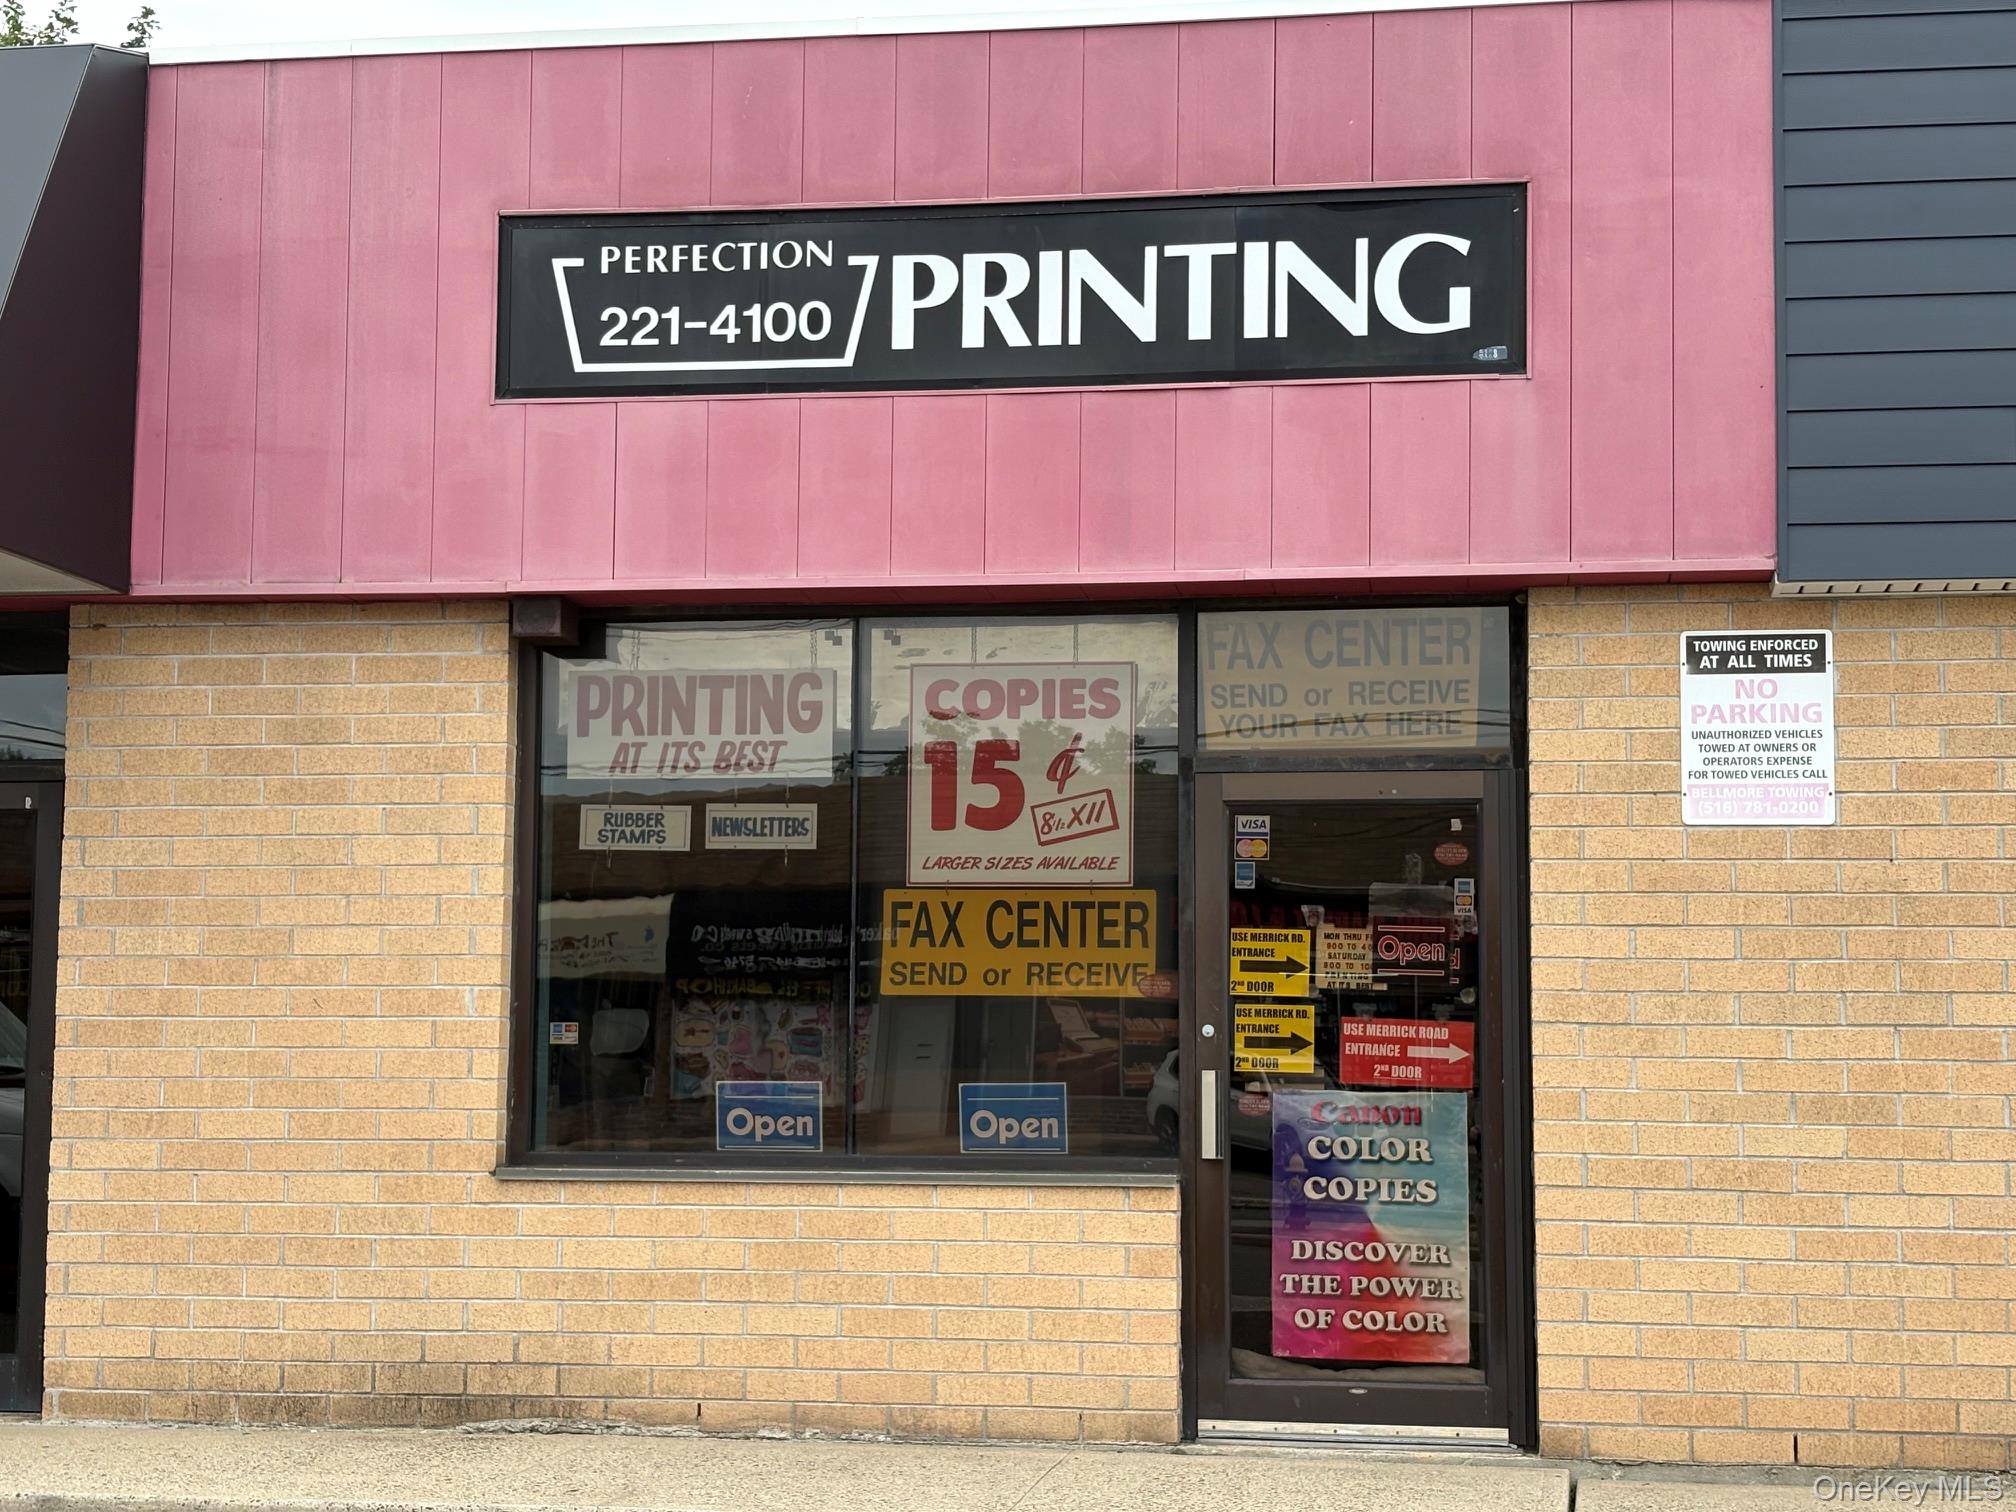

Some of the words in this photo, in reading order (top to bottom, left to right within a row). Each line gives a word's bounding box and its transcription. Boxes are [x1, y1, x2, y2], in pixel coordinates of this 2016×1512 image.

[600, 240, 833, 274] PERFECTION
[890, 232, 1473, 351] PRINTING
[600, 301, 832, 346] 221-4100
[1206, 621, 1282, 670] FAX
[1304, 616, 1471, 669] CENTER
[1693, 640, 1746, 652] TOWING
[1750, 639, 1818, 650] ENFORCED
[1700, 655, 1720, 668] AT
[1728, 654, 1756, 668] ALL
[1764, 654, 1812, 668] TIMES
[1210, 682, 1288, 709] SEND
[1304, 688, 1332, 706] or
[1348, 679, 1470, 705] RECEIVE
[1735, 678, 1778, 700] NO
[576, 672, 824, 738] PRINTING
[925, 678, 1121, 721] COPIES
[1690, 702, 1823, 724] PARKING
[1218, 713, 1298, 739] YOUR
[1314, 713, 1370, 738] FAX
[1385, 711, 1462, 736] HERE
[1691, 730, 1772, 740] UNAUTHORIZED
[1774, 730, 1823, 738] VEHICLES
[1698, 744, 1735, 752] TOWED
[1738, 744, 1750, 752] AT
[1754, 743, 1798, 752] OWNERS
[1802, 742, 1816, 752] OR
[608, 742, 648, 774] AT
[657, 741, 705, 774] ITS
[713, 740, 788, 774] BEST
[1702, 757, 1764, 766] OPERATORS
[1766, 756, 1812, 766] EXPENSE
[1688, 770, 1708, 780] FOR
[1711, 770, 1748, 779] TOWED
[1750, 770, 1799, 779] VEHICLES
[1802, 769, 1828, 778] CALL
[1692, 788, 1764, 798] BELLMORE
[1768, 786, 1824, 798] TOWING
[1699, 802, 1738, 816] (516)
[603, 812, 665, 828] RUBBER
[711, 816, 810, 837] NEWSLETTERS
[1240, 819, 1267, 830] VISA
[597, 829, 667, 844] STAMPS
[922, 856, 980, 870] LARGER
[984, 856, 1034, 870] SIZES
[1036, 856, 1121, 870] AVAILABLE
[890, 900, 965, 948] FAX
[986, 900, 1150, 949] CENTER
[1232, 932, 1249, 942] USE
[1250, 932, 1290, 942] MERRICK
[1291, 934, 1305, 942] RD.
[1324, 932, 1340, 940] MON
[1232, 948, 1276, 958] ENTRANCE
[1328, 952, 1366, 960] SATURDAY
[1378, 934, 1445, 964] Open
[889, 961, 968, 986] SEND
[982, 967, 1012, 986] or
[1026, 962, 1149, 986] RECEIVE
[1247, 982, 1274, 992] DOOR
[1236, 1008, 1252, 1018] USE
[1254, 1008, 1294, 1018] MERRICK
[1296, 1010, 1310, 1018] RD.
[1236, 1024, 1280, 1034] ENTRANCE
[1344, 1022, 1364, 1035] USE
[1366, 1024, 1416, 1038] MERRICK
[1418, 1026, 1448, 1040] ROAD
[1345, 1042, 1400, 1056] ENTRANCE
[1252, 1057, 1278, 1068] DOOR
[1391, 1065, 1422, 1078] DOOR
[1310, 1100, 1422, 1126] Canon
[726, 1108, 814, 1142] Open
[970, 1110, 1059, 1144] Open
[1308, 1136, 1433, 1162] COLOR
[1303, 1176, 1438, 1203] COPIES
[1290, 1240, 1451, 1264] DISCOVER
[1280, 1274, 1341, 1296] THE
[1350, 1276, 1462, 1300] POWER
[1294, 1308, 1336, 1329] OF
[1342, 1310, 1448, 1333] COLOR
